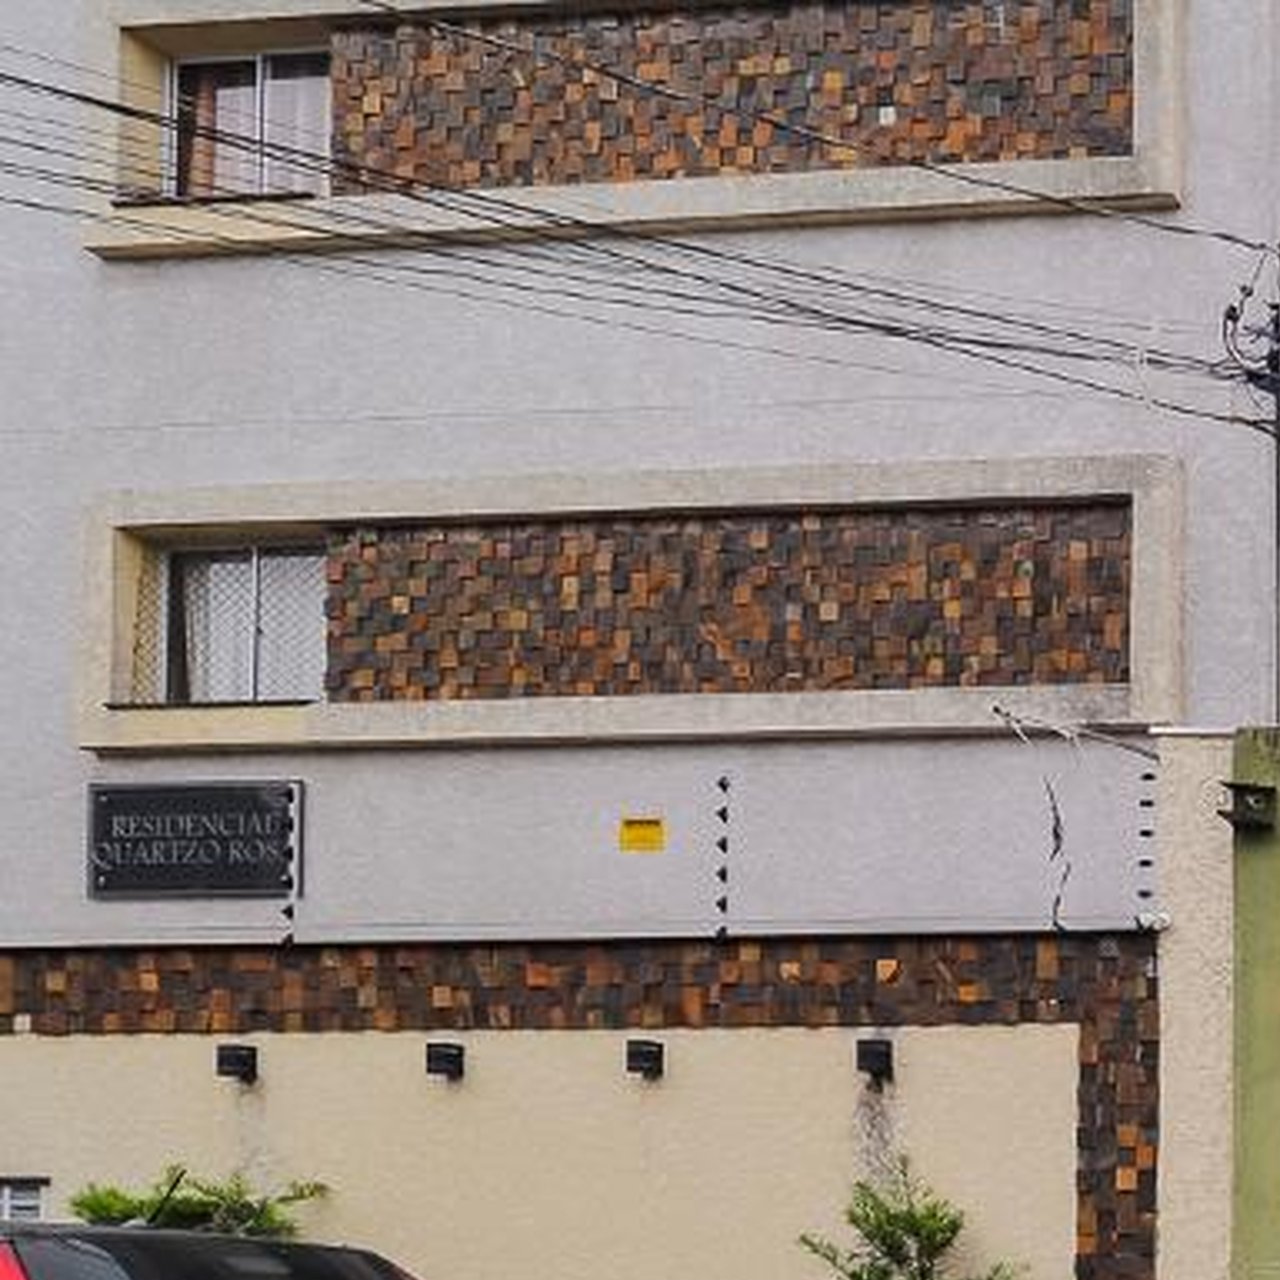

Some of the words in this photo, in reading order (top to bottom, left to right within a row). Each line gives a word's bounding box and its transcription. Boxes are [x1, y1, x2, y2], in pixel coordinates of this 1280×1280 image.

[111, 813, 281, 837] RESIDENCIAL
[91, 839, 221, 869] QUARTZO
[229, 839, 286, 865] ROS
